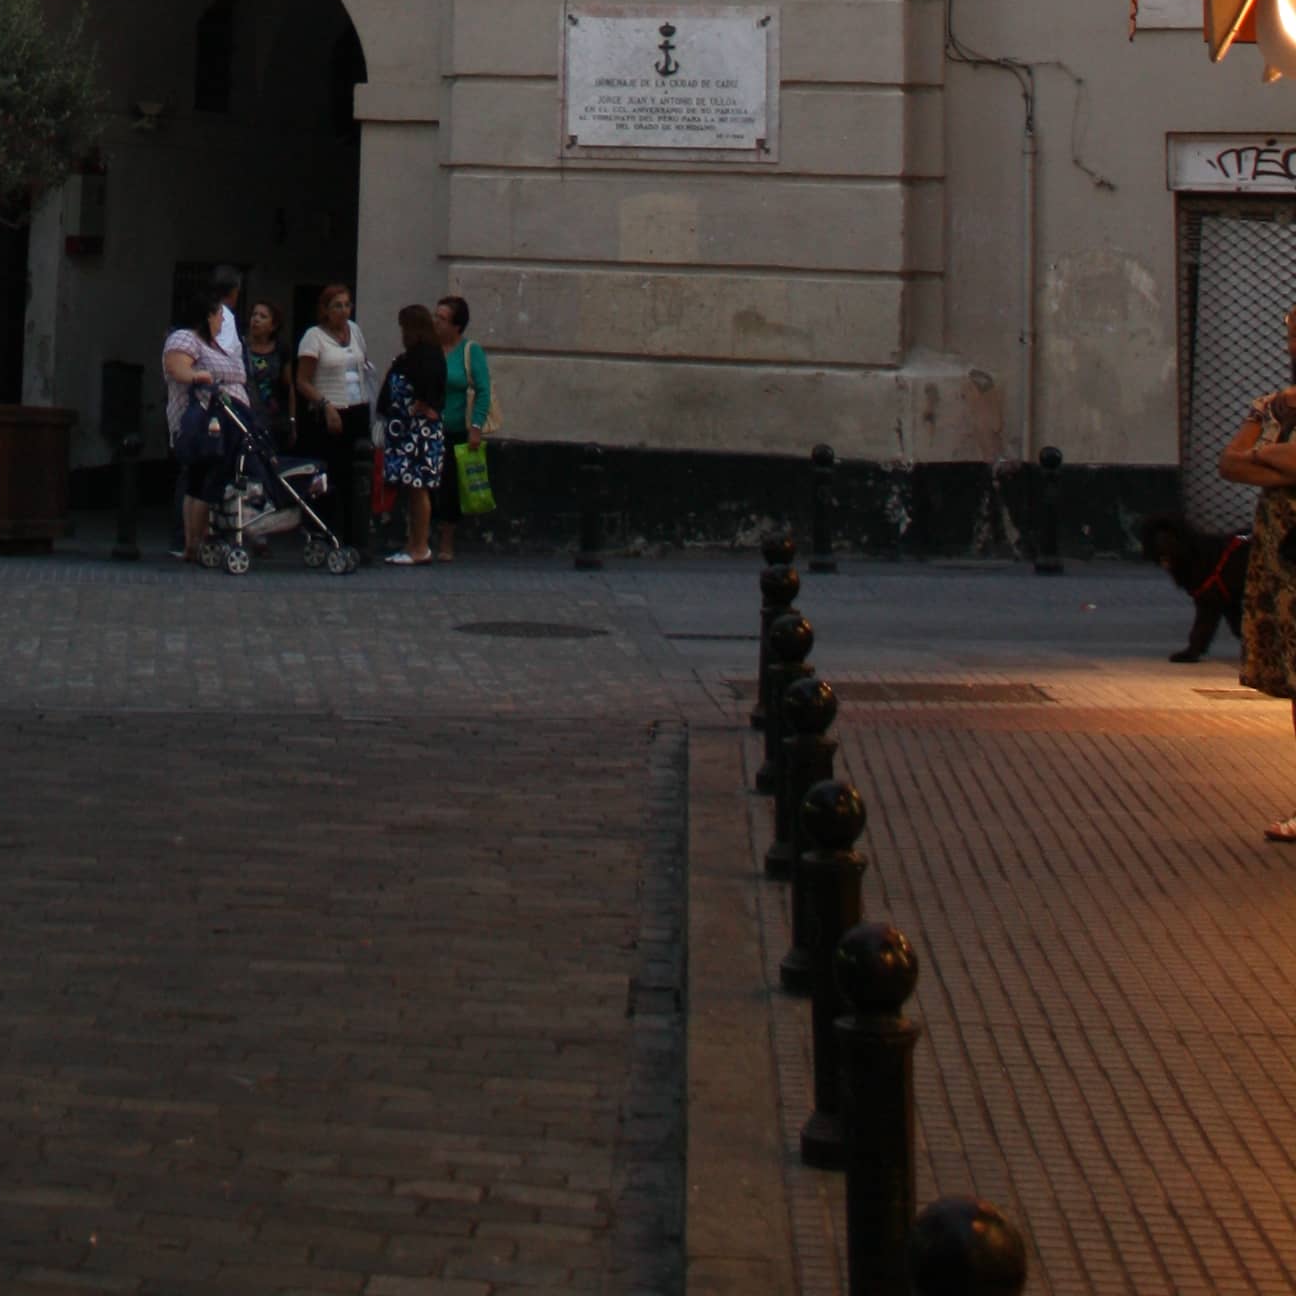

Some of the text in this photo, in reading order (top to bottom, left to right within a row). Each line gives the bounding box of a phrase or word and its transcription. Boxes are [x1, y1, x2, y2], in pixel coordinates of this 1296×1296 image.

[594, 79, 636, 88] HOMENAJE
[640, 79, 650, 88] DE
[655, 79, 666, 88] LA
[669, 79, 698, 88] CIUDAD
[701, 79, 711, 88] DE
[598, 96, 621, 105] JORGE
[628, 96, 647, 105] JUAN
[660, 96, 692, 105] ANTONIO
[696, 96, 706, 105] DE
[710, 96, 736, 105] ULLOA
[686, 106, 696, 114] DE
